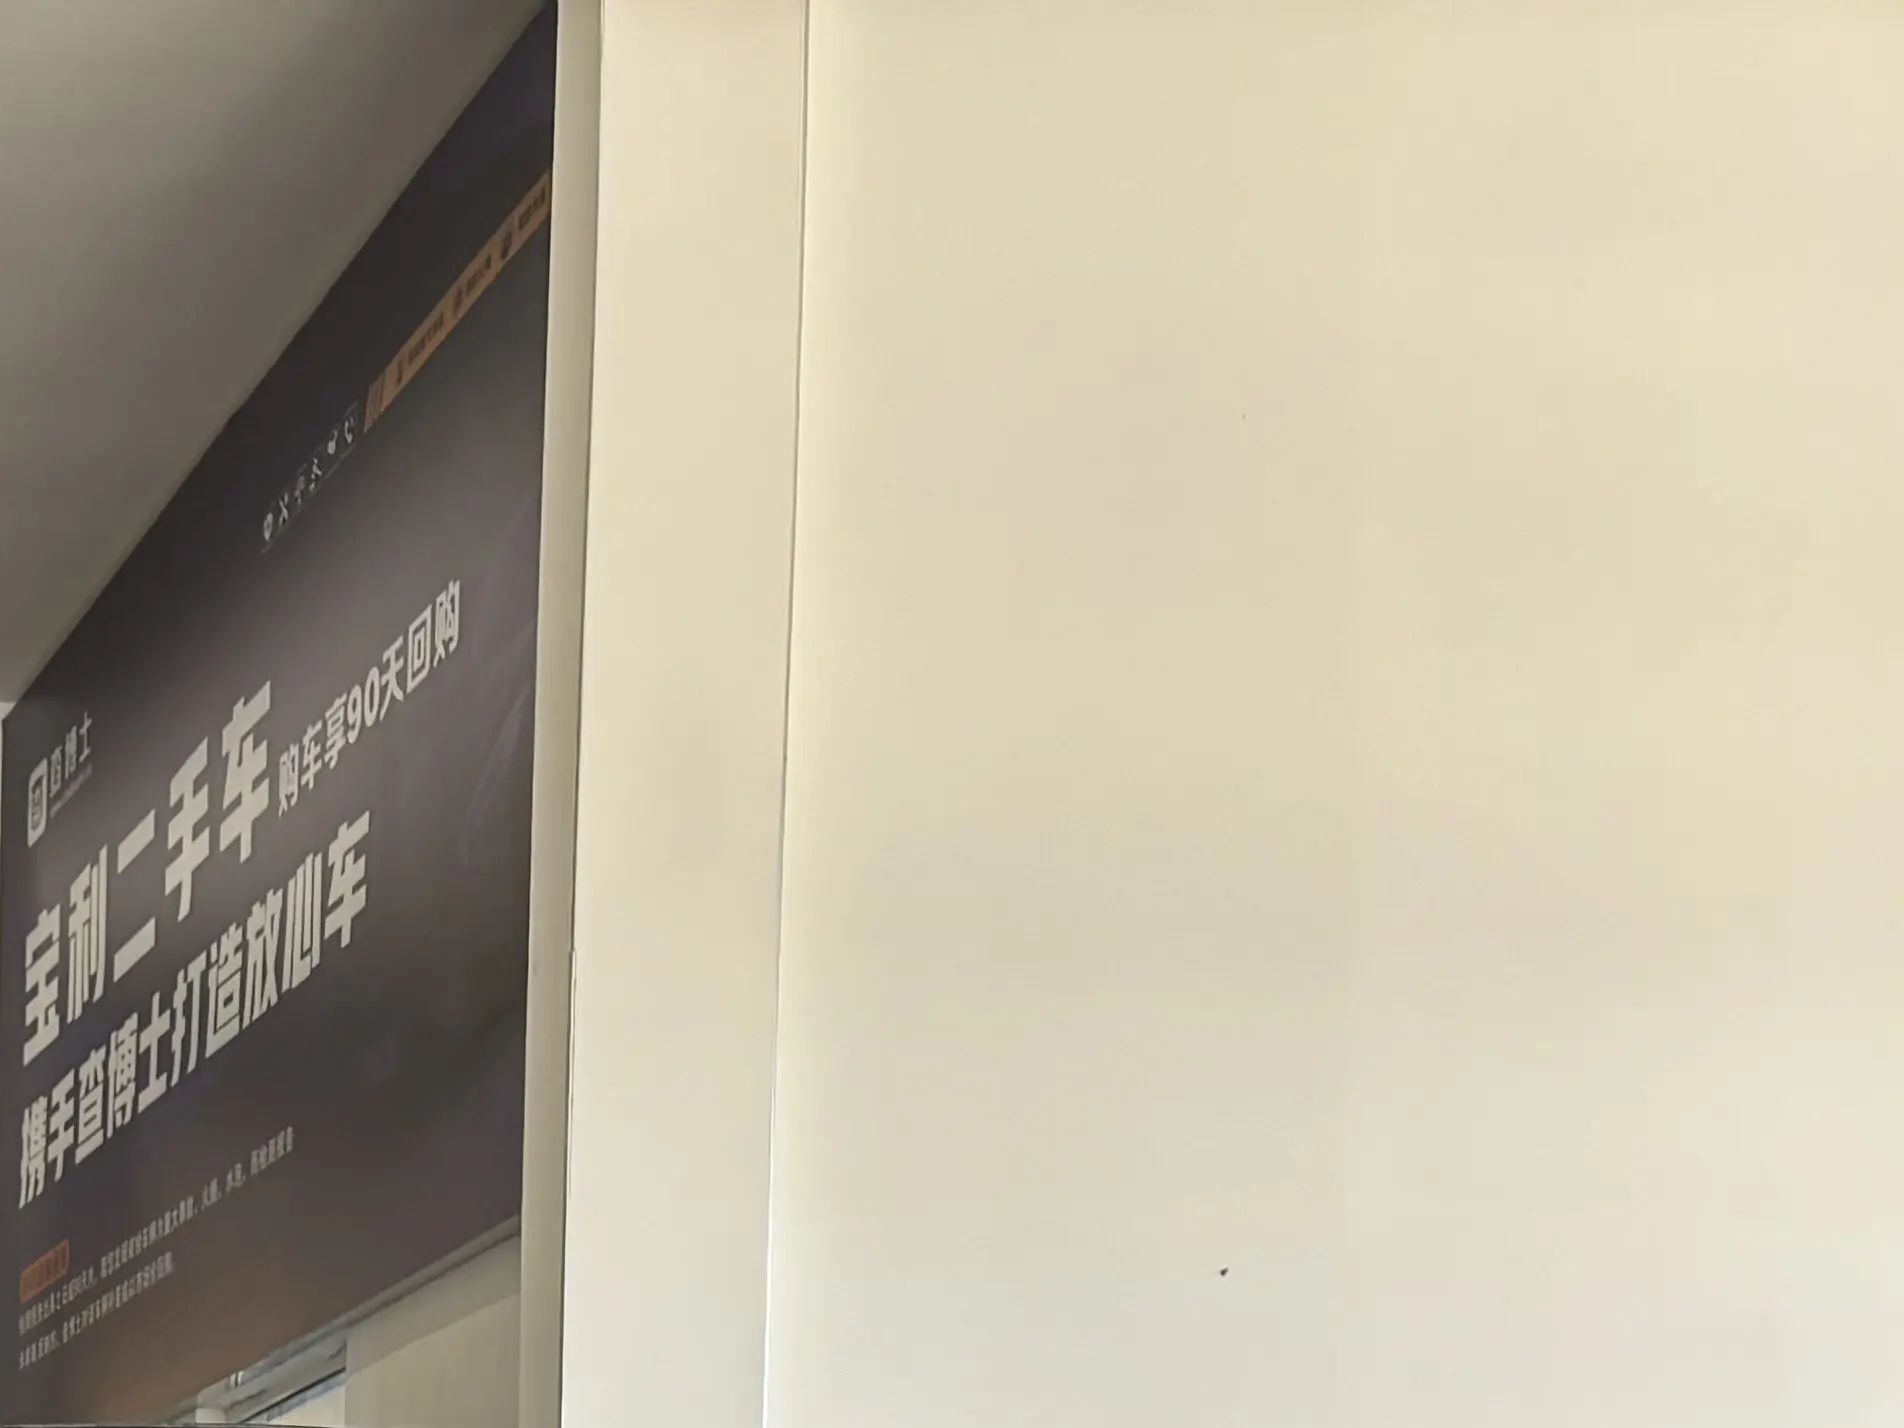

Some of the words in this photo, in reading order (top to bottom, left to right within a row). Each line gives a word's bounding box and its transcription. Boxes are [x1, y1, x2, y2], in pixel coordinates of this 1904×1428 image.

[23, 681, 271, 1067] 宝利二手车
[278, 579, 461, 817] 购车享90天回购
[19, 811, 370, 1209] 携手查博士打造放心车
